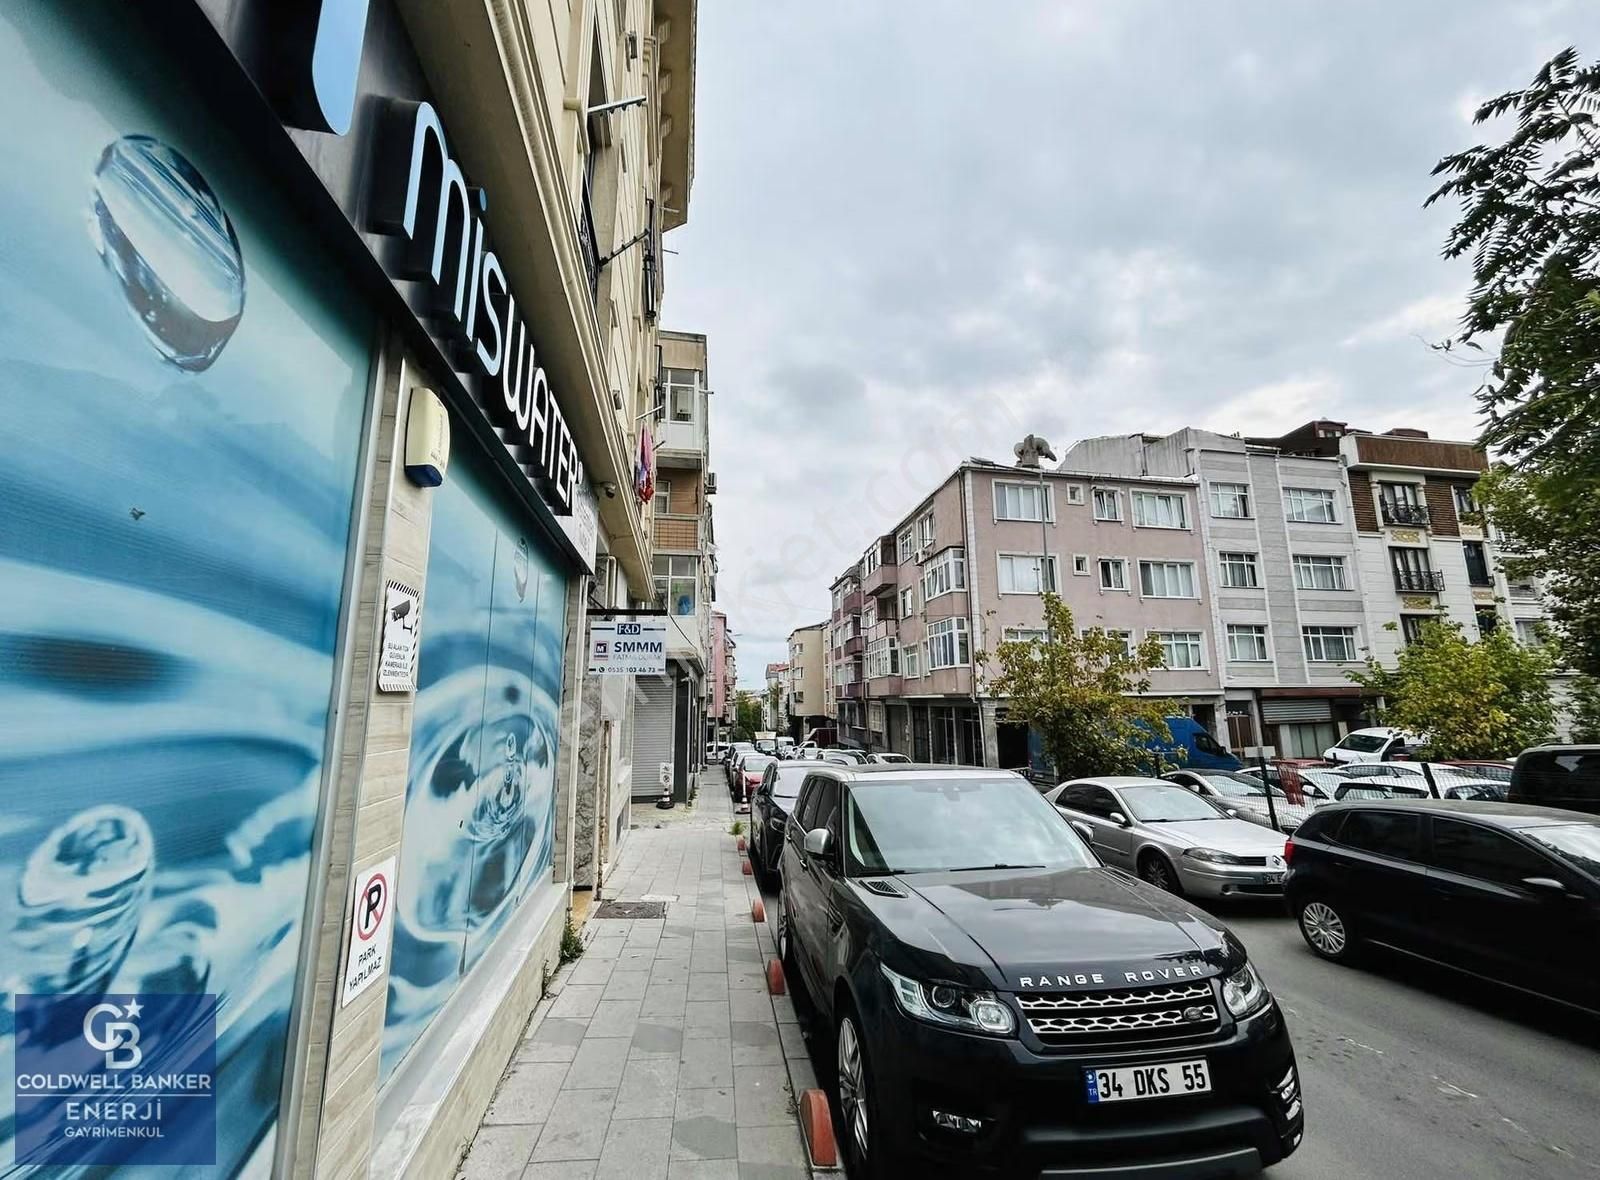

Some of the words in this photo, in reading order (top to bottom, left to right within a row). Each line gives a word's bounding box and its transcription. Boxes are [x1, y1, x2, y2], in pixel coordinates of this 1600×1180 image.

[618, 624, 640, 634] F&D
[614, 641, 662, 652] SMMM
[358, 944, 377, 966] PARK
[348, 956, 382, 992] YAPILMAZ
[1020, 973, 1105, 988] RANGE
[1124, 965, 1204, 983] ROVER
[1098, 1072, 1124, 1099] 34
[1133, 1067, 1170, 1096] DKS
[1181, 1064, 1207, 1091] 55
